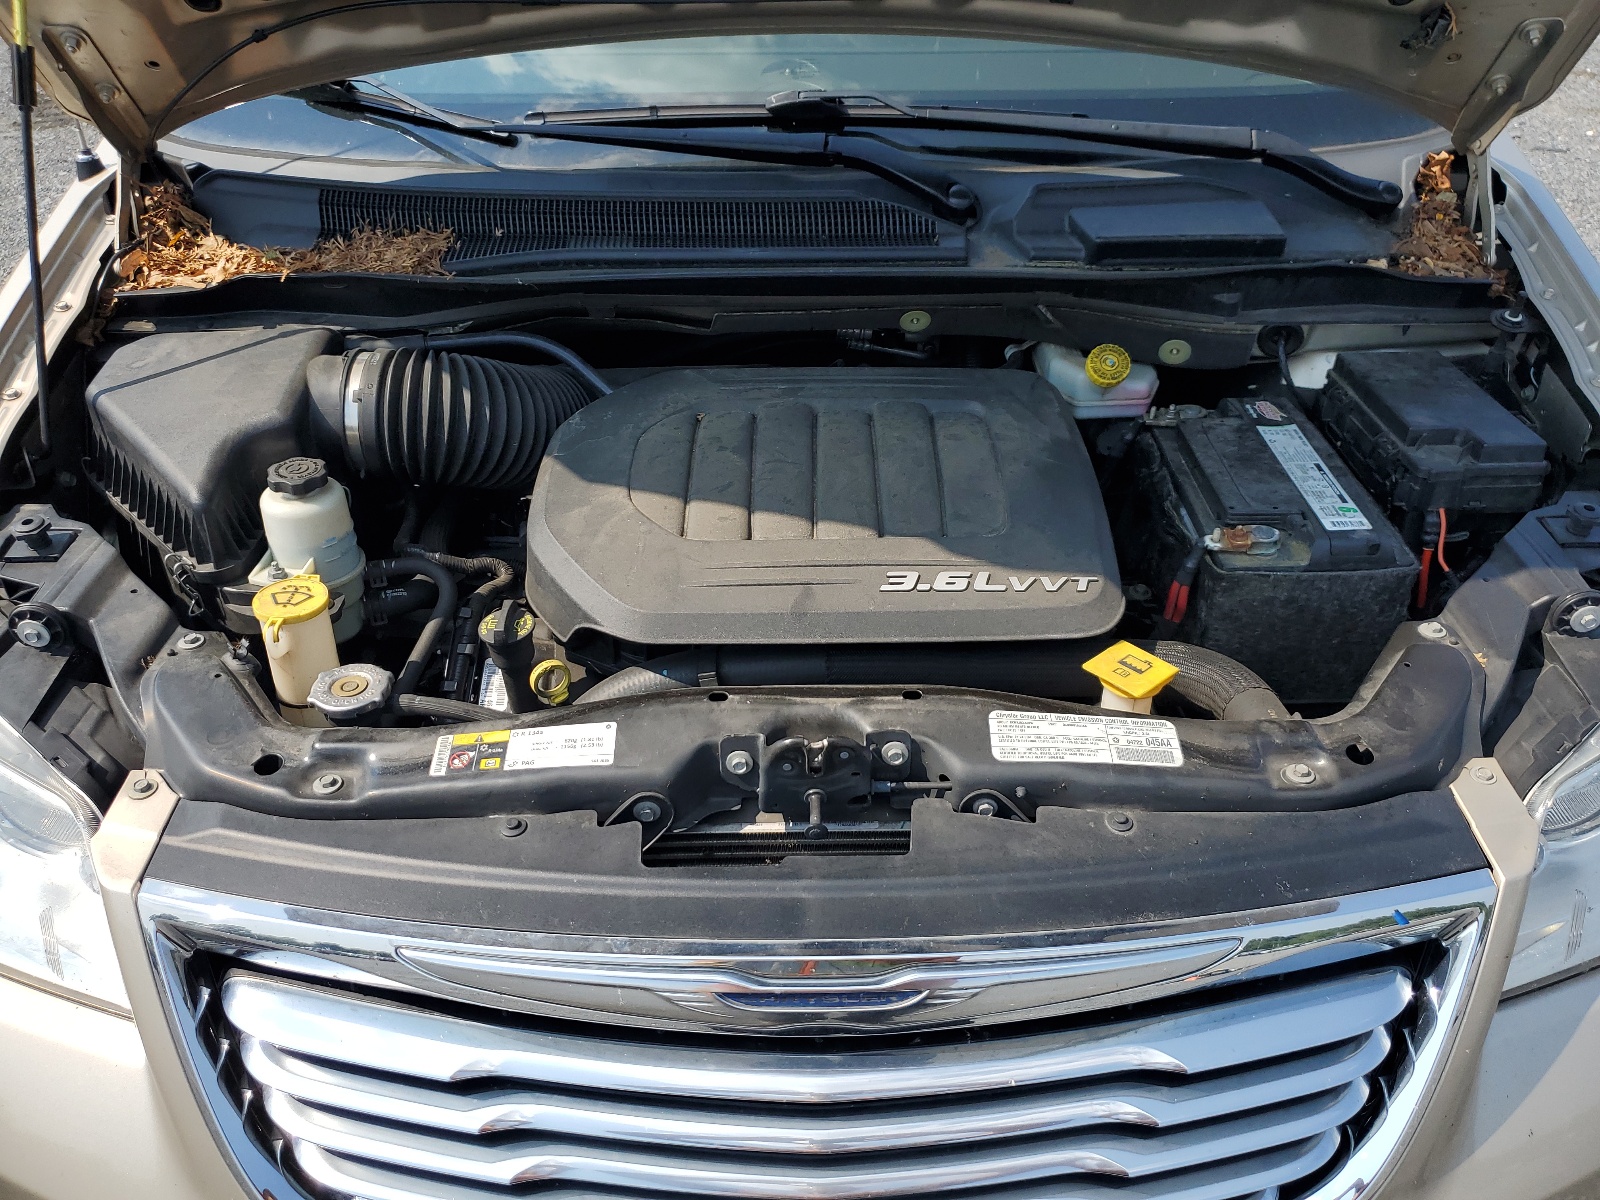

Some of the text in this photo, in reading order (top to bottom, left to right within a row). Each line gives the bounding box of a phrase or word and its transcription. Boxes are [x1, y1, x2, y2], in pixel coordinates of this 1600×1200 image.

[879, 571, 1099, 592] 3.6L VVT
[1145, 737, 1173, 748] 045AA
